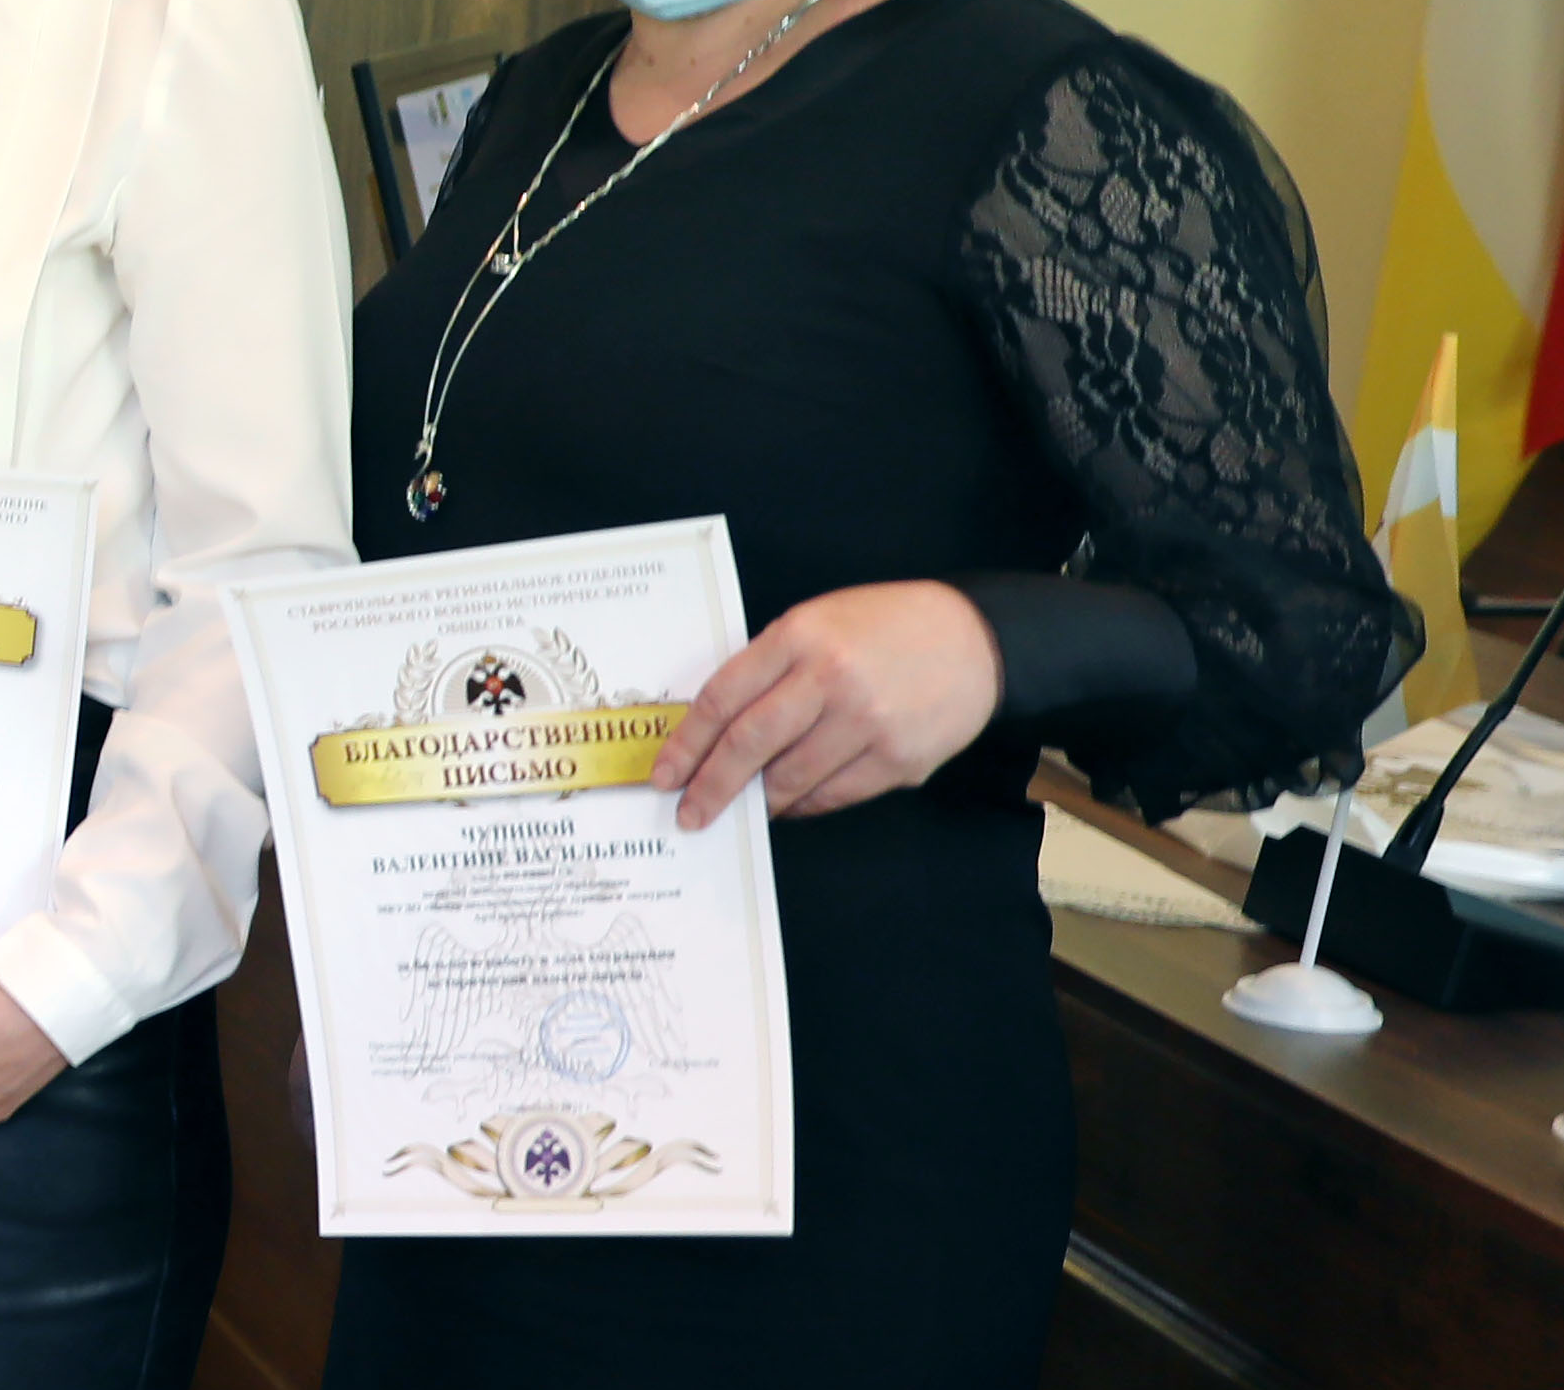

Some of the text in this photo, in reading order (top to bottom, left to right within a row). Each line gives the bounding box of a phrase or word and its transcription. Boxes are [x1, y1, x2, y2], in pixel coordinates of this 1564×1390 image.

[344, 715, 670, 765] БЛАГОДАРСТВЕННОЕ
[443, 759, 579, 790] ПИСЬМО
[461, 816, 576, 844] ЧУПИНОЙ
